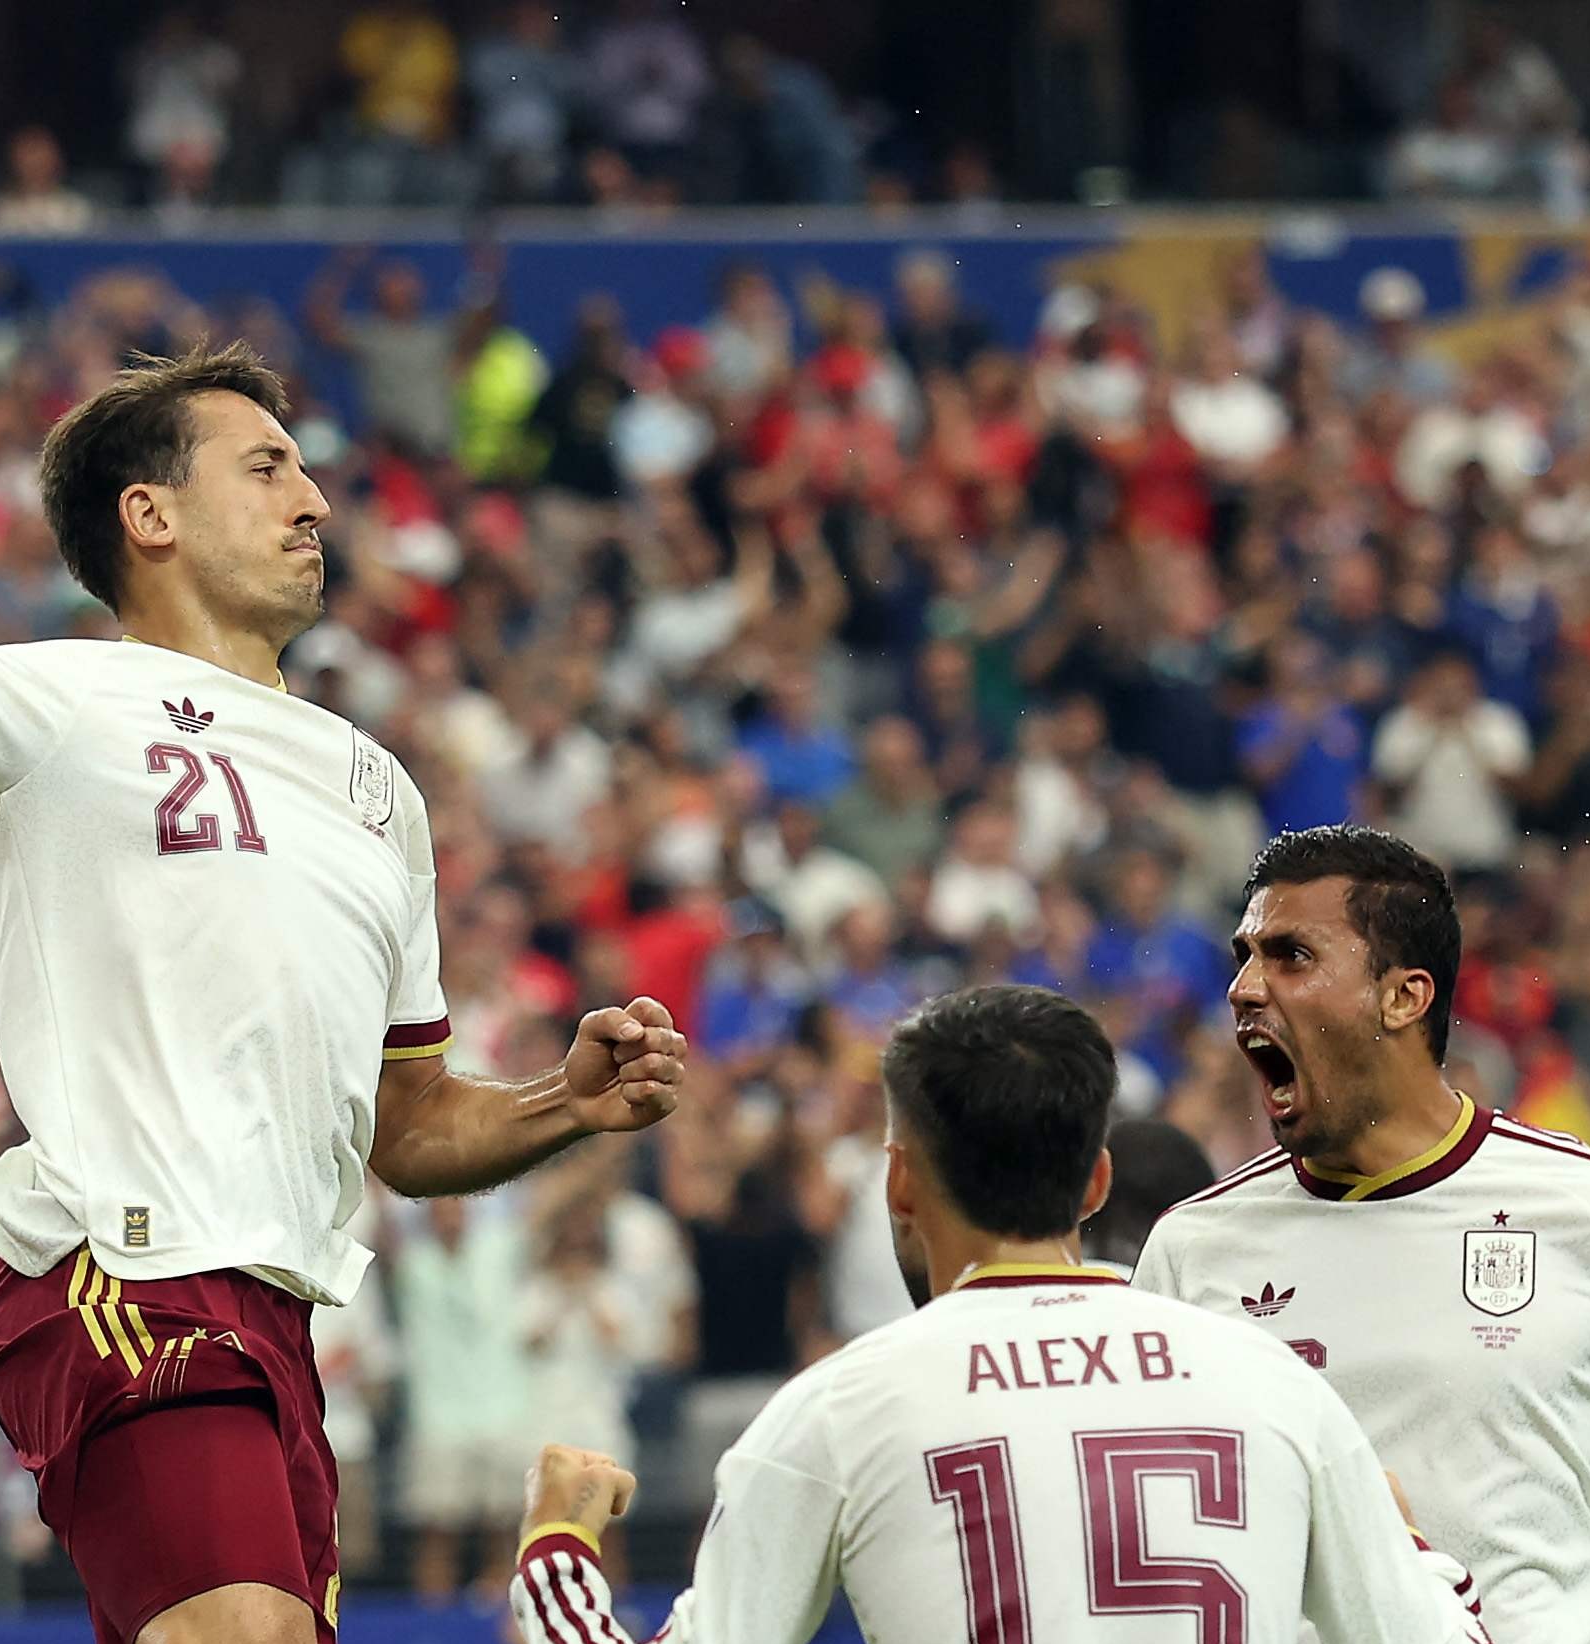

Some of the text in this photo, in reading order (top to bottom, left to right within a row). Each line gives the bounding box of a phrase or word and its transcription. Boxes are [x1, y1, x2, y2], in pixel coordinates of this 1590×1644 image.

[144, 741, 268, 856] 21
[966, 1330, 1192, 1394] ALEX B.
